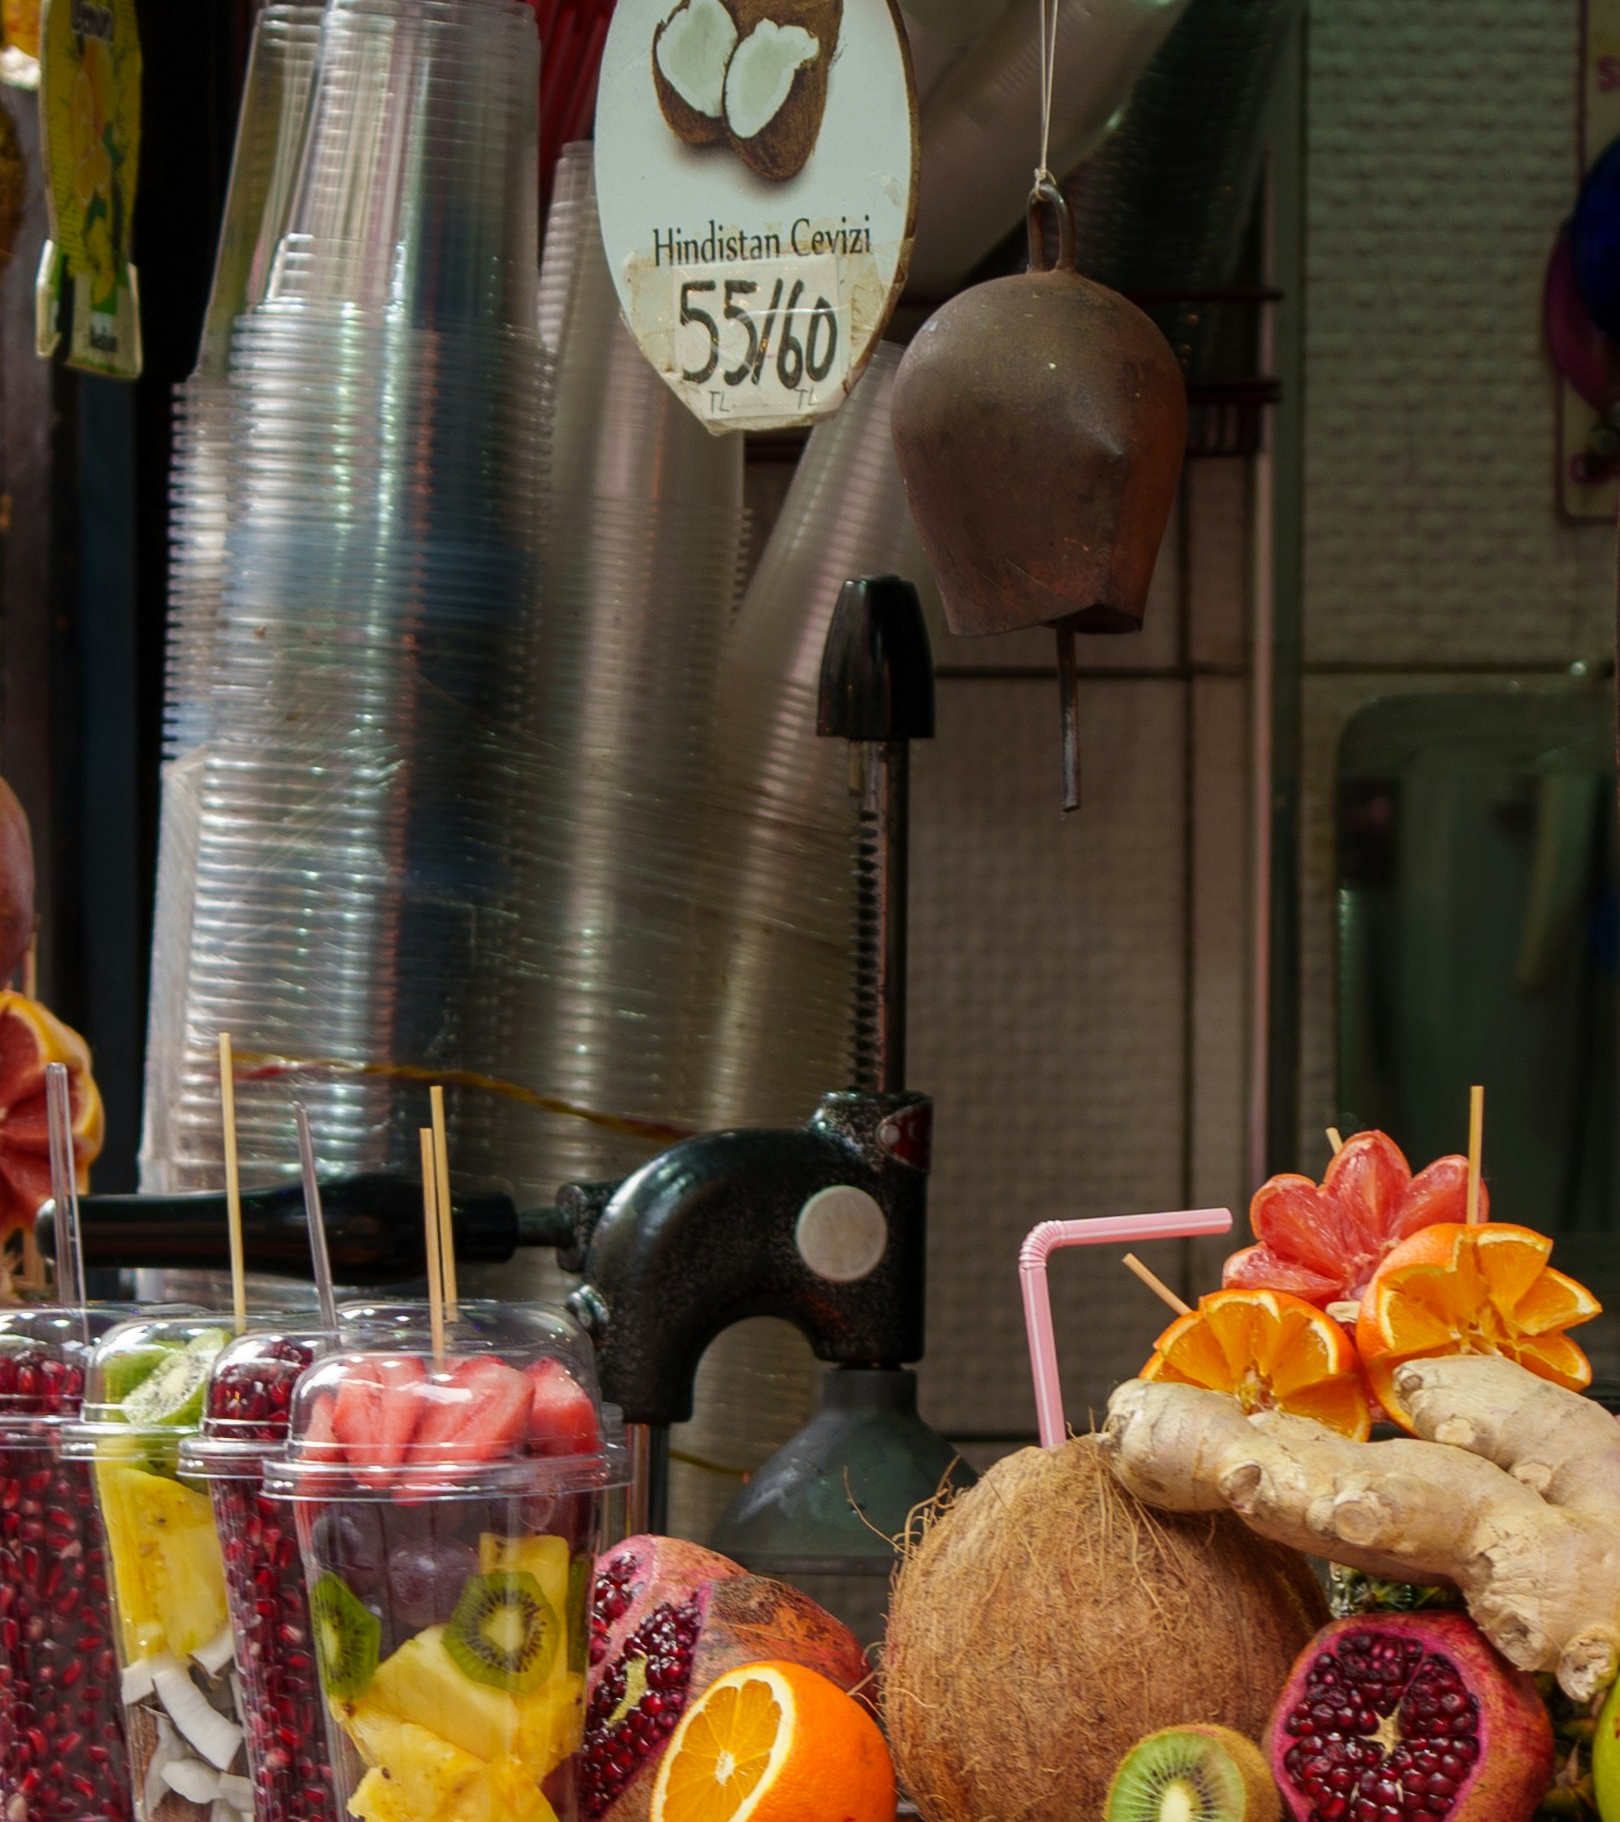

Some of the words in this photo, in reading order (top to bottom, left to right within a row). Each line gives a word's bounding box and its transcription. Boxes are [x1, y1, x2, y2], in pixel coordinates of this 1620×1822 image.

[653, 220, 780, 266] Hindistan
[791, 216, 872, 257] Cevizi
[679, 277, 839, 389] 55/60
[709, 390, 730, 414] TL
[795, 388, 818, 409] TL
